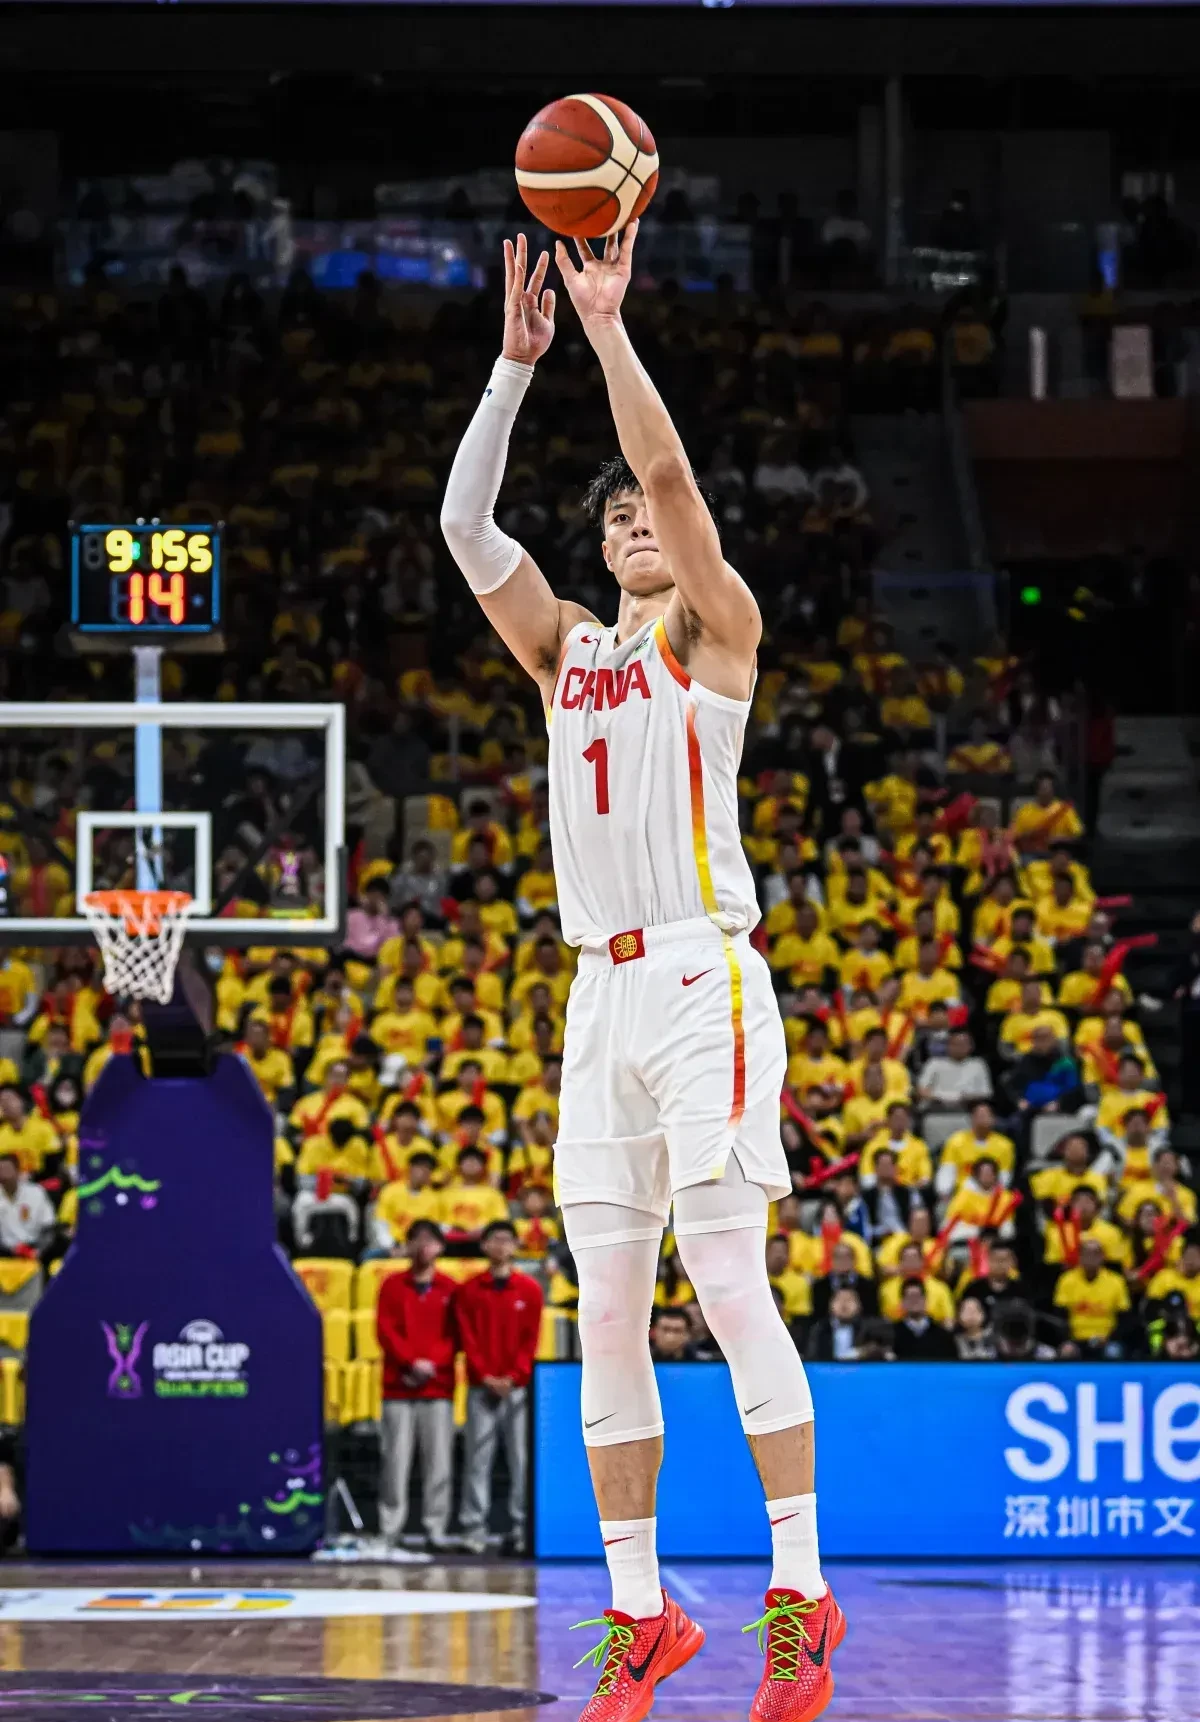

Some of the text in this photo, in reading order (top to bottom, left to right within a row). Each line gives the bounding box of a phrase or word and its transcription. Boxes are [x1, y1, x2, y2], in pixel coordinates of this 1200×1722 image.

[130, 573, 184, 624] 14
[582, 738, 610, 815] 1
[1004, 1495, 1196, 1537] 深圳市文
